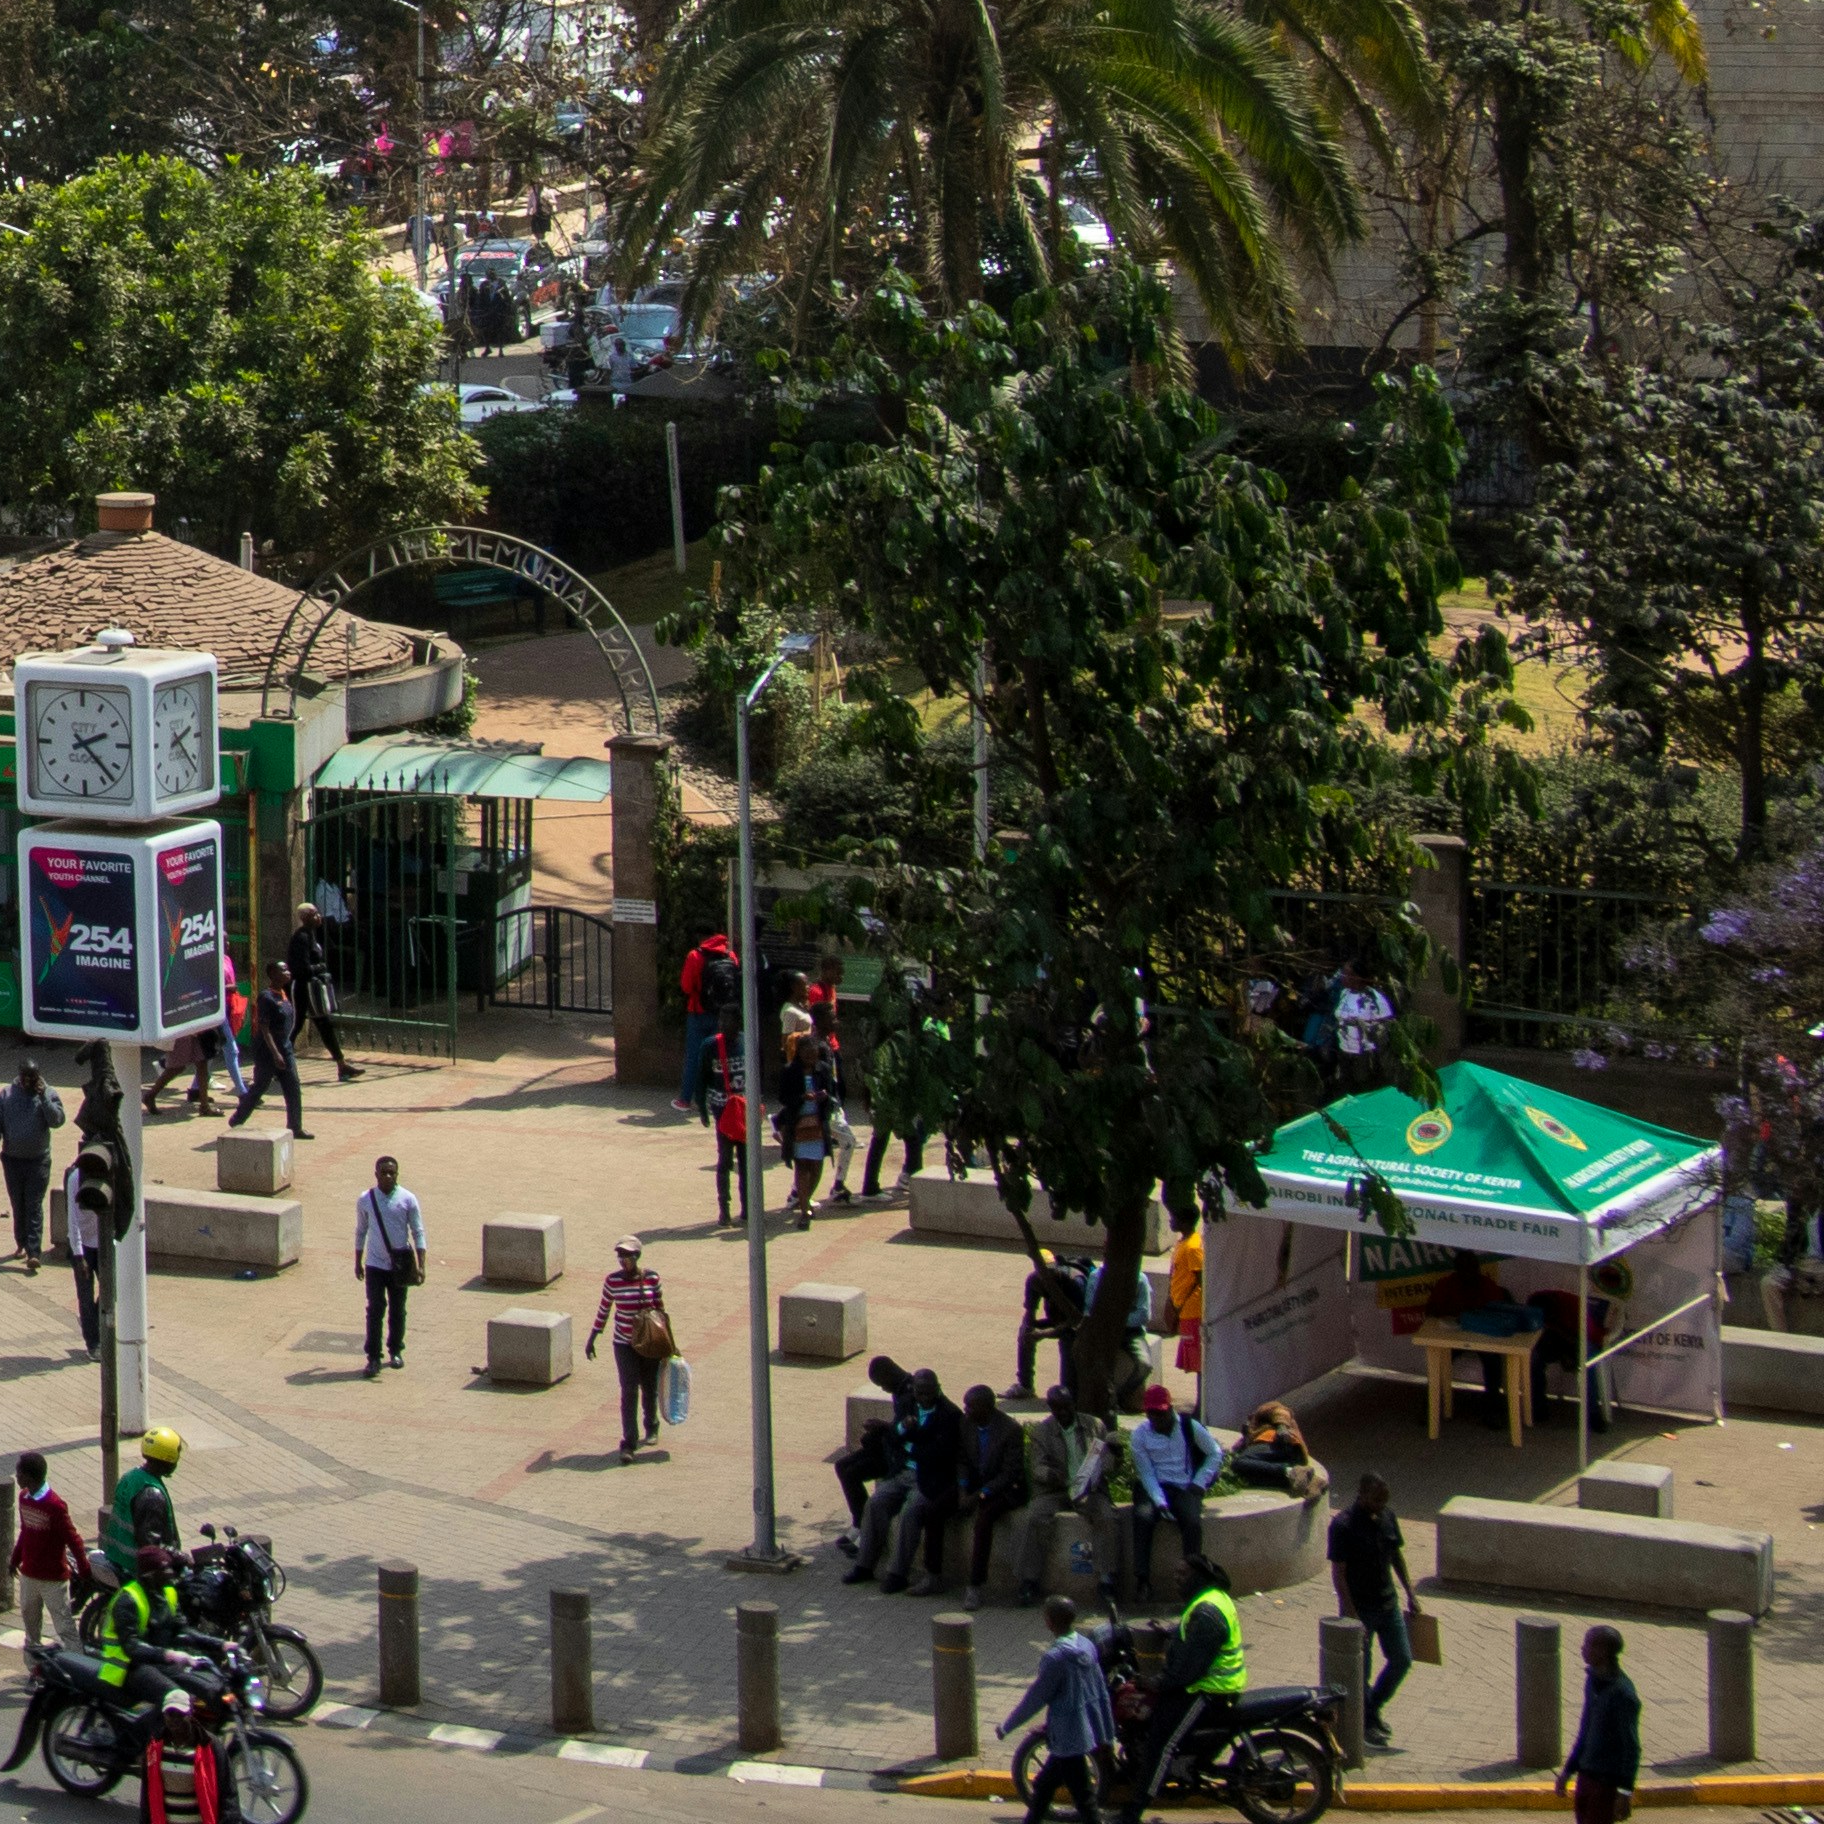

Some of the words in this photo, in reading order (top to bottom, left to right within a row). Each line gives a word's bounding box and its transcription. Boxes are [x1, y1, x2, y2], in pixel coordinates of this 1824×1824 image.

[448, 533, 602, 621] MEMORIAL
[71, 721, 98, 734] CITY
[47, 857, 77, 870] YOUR
[79, 860, 132, 875] FAVORITE
[166, 856, 184, 868] YOUR
[184, 845, 215, 862] FAVORITE
[48, 872, 74, 882] YOUTH
[75, 874, 111, 884] CHANNEL
[166, 869, 182, 881] YOUTH
[182, 862, 203, 876] CHANNEL
[180, 909, 216, 946] 254
[69, 924, 133, 955] 254
[184, 940, 215, 961] IMAGINE
[75, 955, 132, 970] IMAGINE
[1301, 1149, 1326, 1164] THE
[1412, 1163, 1464, 1182] SOCIETY
[1463, 1171, 1482, 1184] OF
[1481, 1174, 1523, 1190] KENYA
[1269, 1186, 1323, 1204] AIROBI
[1461, 1213, 1518, 1232] TRADE
[1522, 1221, 1560, 1238] FAIR
